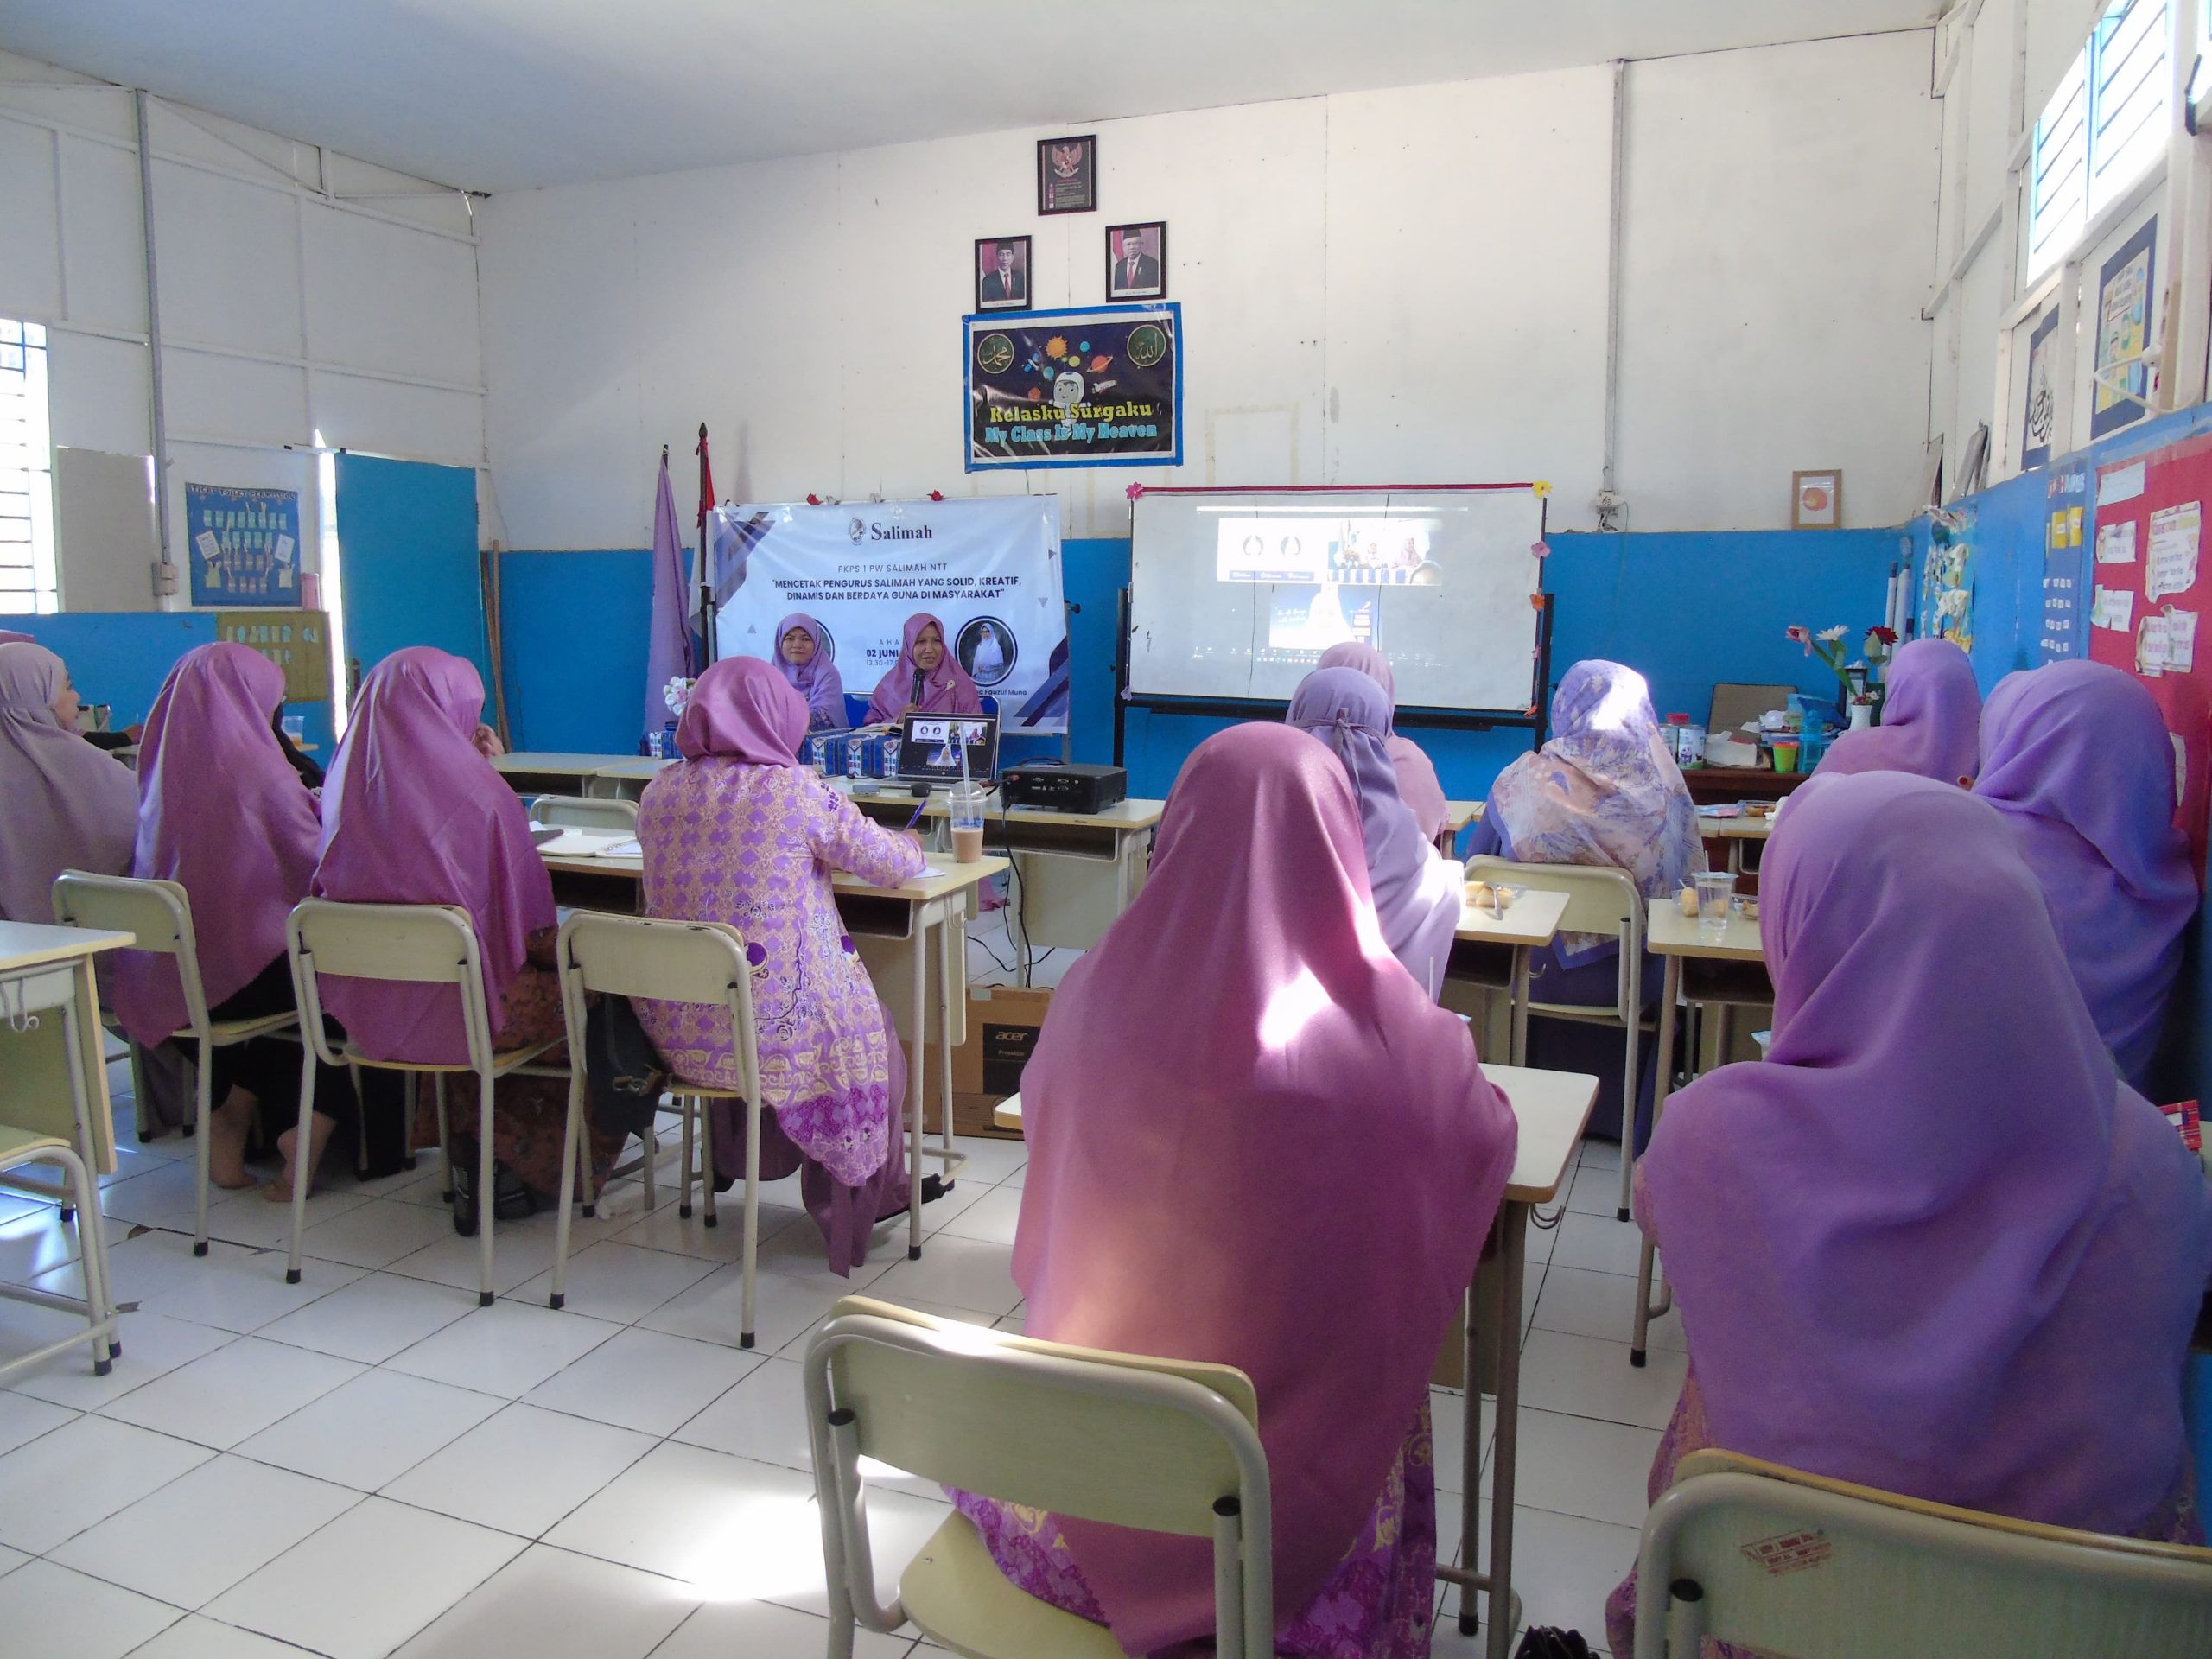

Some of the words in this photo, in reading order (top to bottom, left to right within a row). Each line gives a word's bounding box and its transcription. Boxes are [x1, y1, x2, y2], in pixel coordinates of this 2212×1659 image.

[989, 404, 1066, 423] Kelasku
[1070, 401, 1153, 422] Surgaku
[985, 426, 1007, 447] My
[1011, 425, 1052, 442] Class
[1071, 423, 1095, 443] My
[1097, 422, 1158, 439] Heaven
[871, 521, 933, 541] Salimah
[887, 563, 927, 572] SALIMAH
[930, 563, 948, 571] NTT
[874, 578, 916, 588] SALIMAH
[918, 577, 944, 587] YANG
[946, 577, 977, 587] SOLID,
[979, 576, 1022, 587] KREATIF,
[787, 592, 823, 601] DINAMIS
[825, 592, 845, 601] DAN
[847, 591, 890, 600] BERDAYA
[892, 591, 919, 600] GUNA
[921, 590, 931, 599] DI
[866, 649, 877, 658] 02
[878, 649, 899, 659] JUNI
[995, 1031, 1028, 1041] acer
